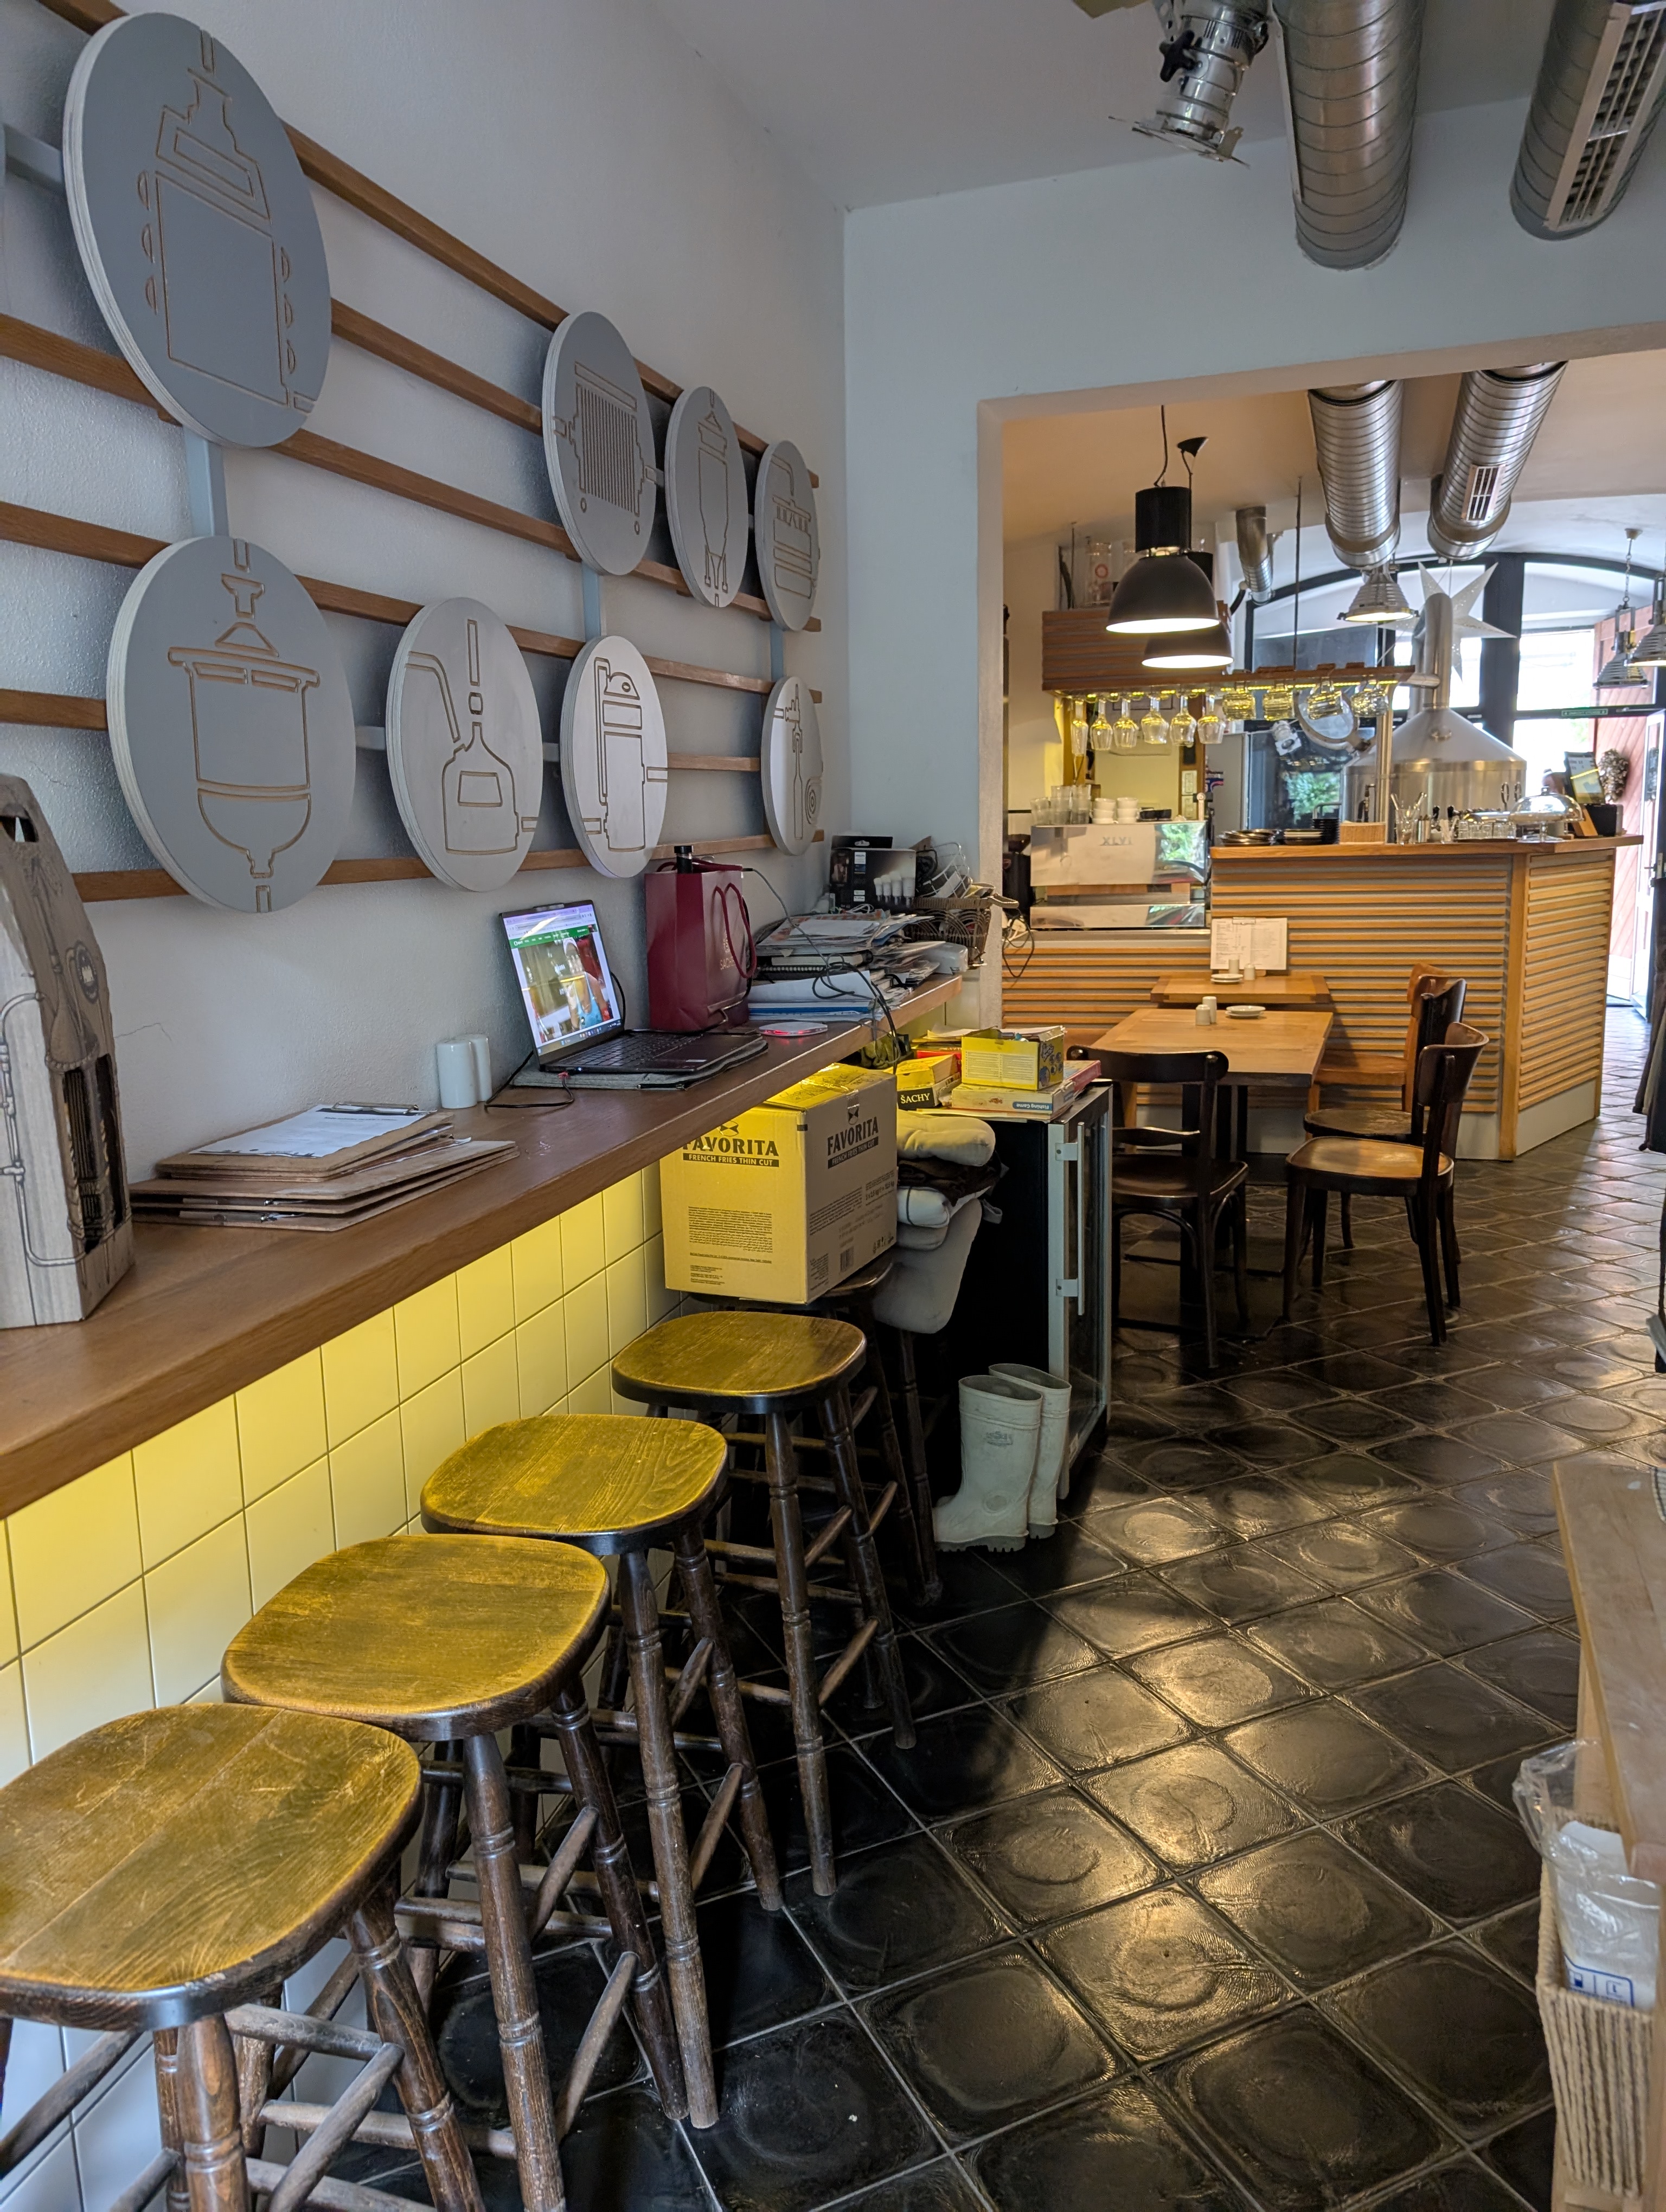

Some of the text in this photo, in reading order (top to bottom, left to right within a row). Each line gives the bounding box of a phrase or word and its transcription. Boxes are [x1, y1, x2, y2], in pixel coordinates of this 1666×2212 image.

[900, 1092, 930, 1104] ŠACHY
[827, 1116, 879, 1156] FAVORITA
[689, 1154, 716, 1162] FRENCH
